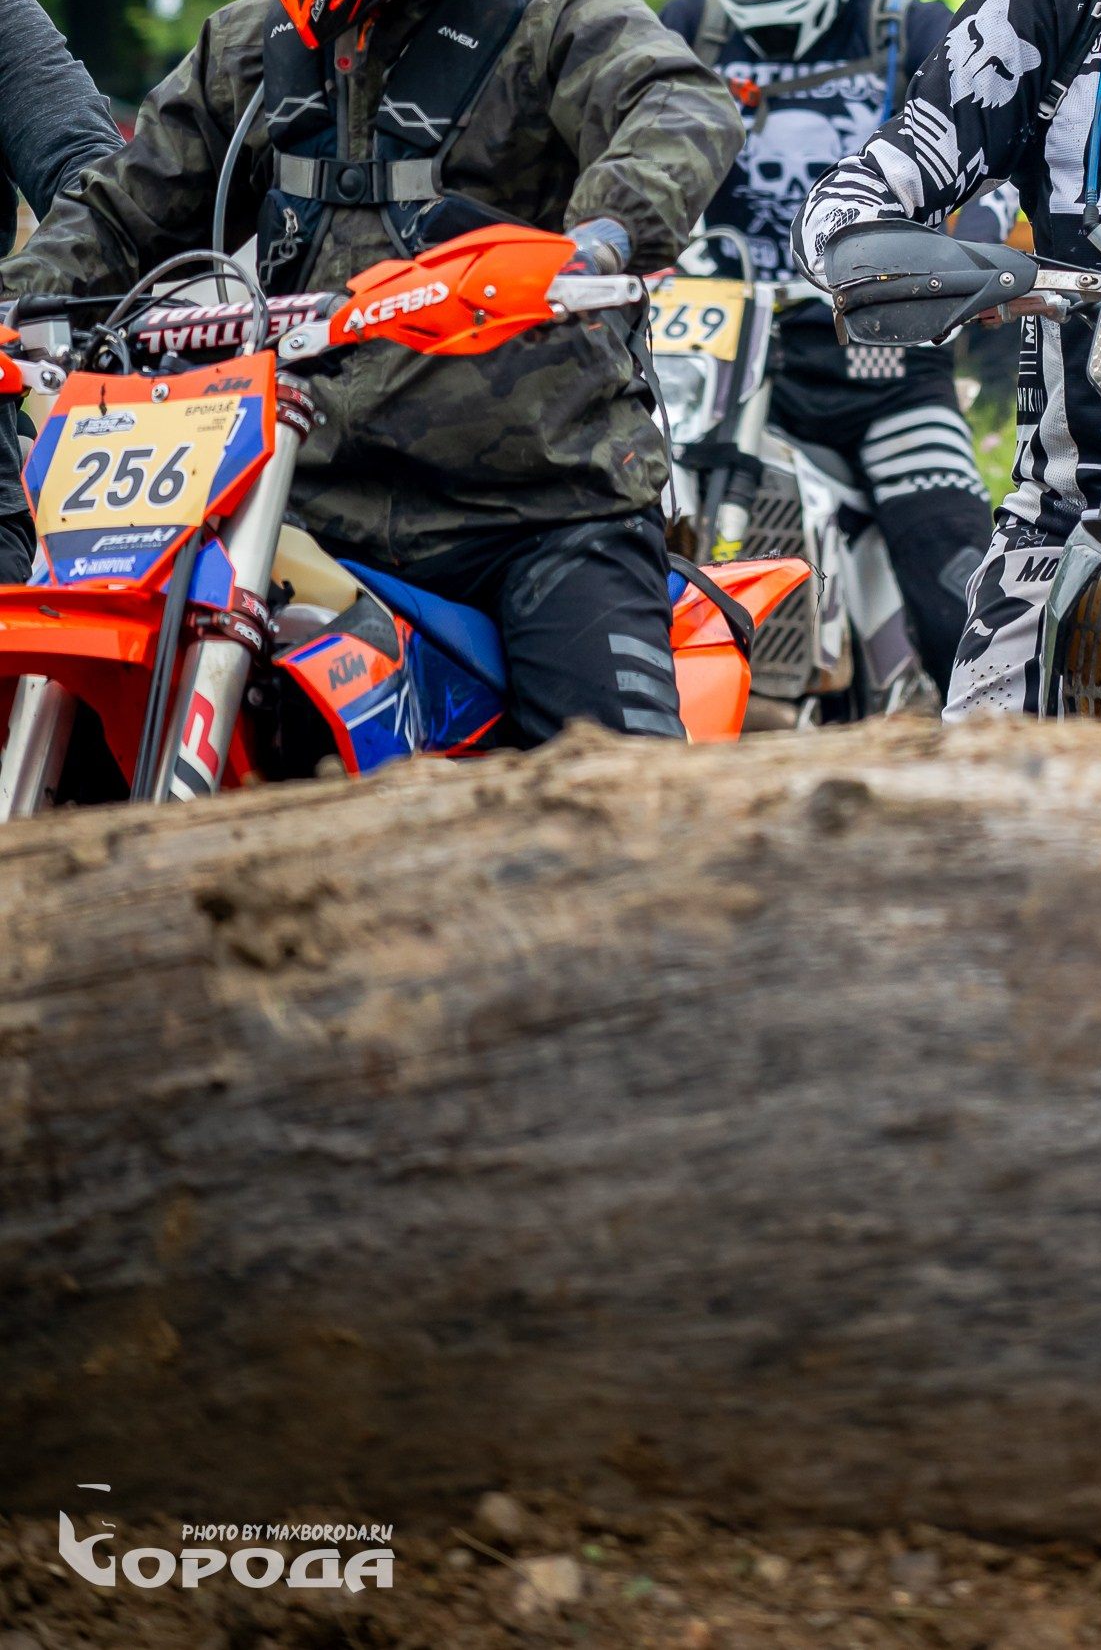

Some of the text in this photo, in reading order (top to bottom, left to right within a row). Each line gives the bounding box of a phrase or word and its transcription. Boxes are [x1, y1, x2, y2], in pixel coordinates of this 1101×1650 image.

[203, 377, 253, 395] KTM
[61, 445, 192, 513] 256
[328, 651, 368, 691] KTM
